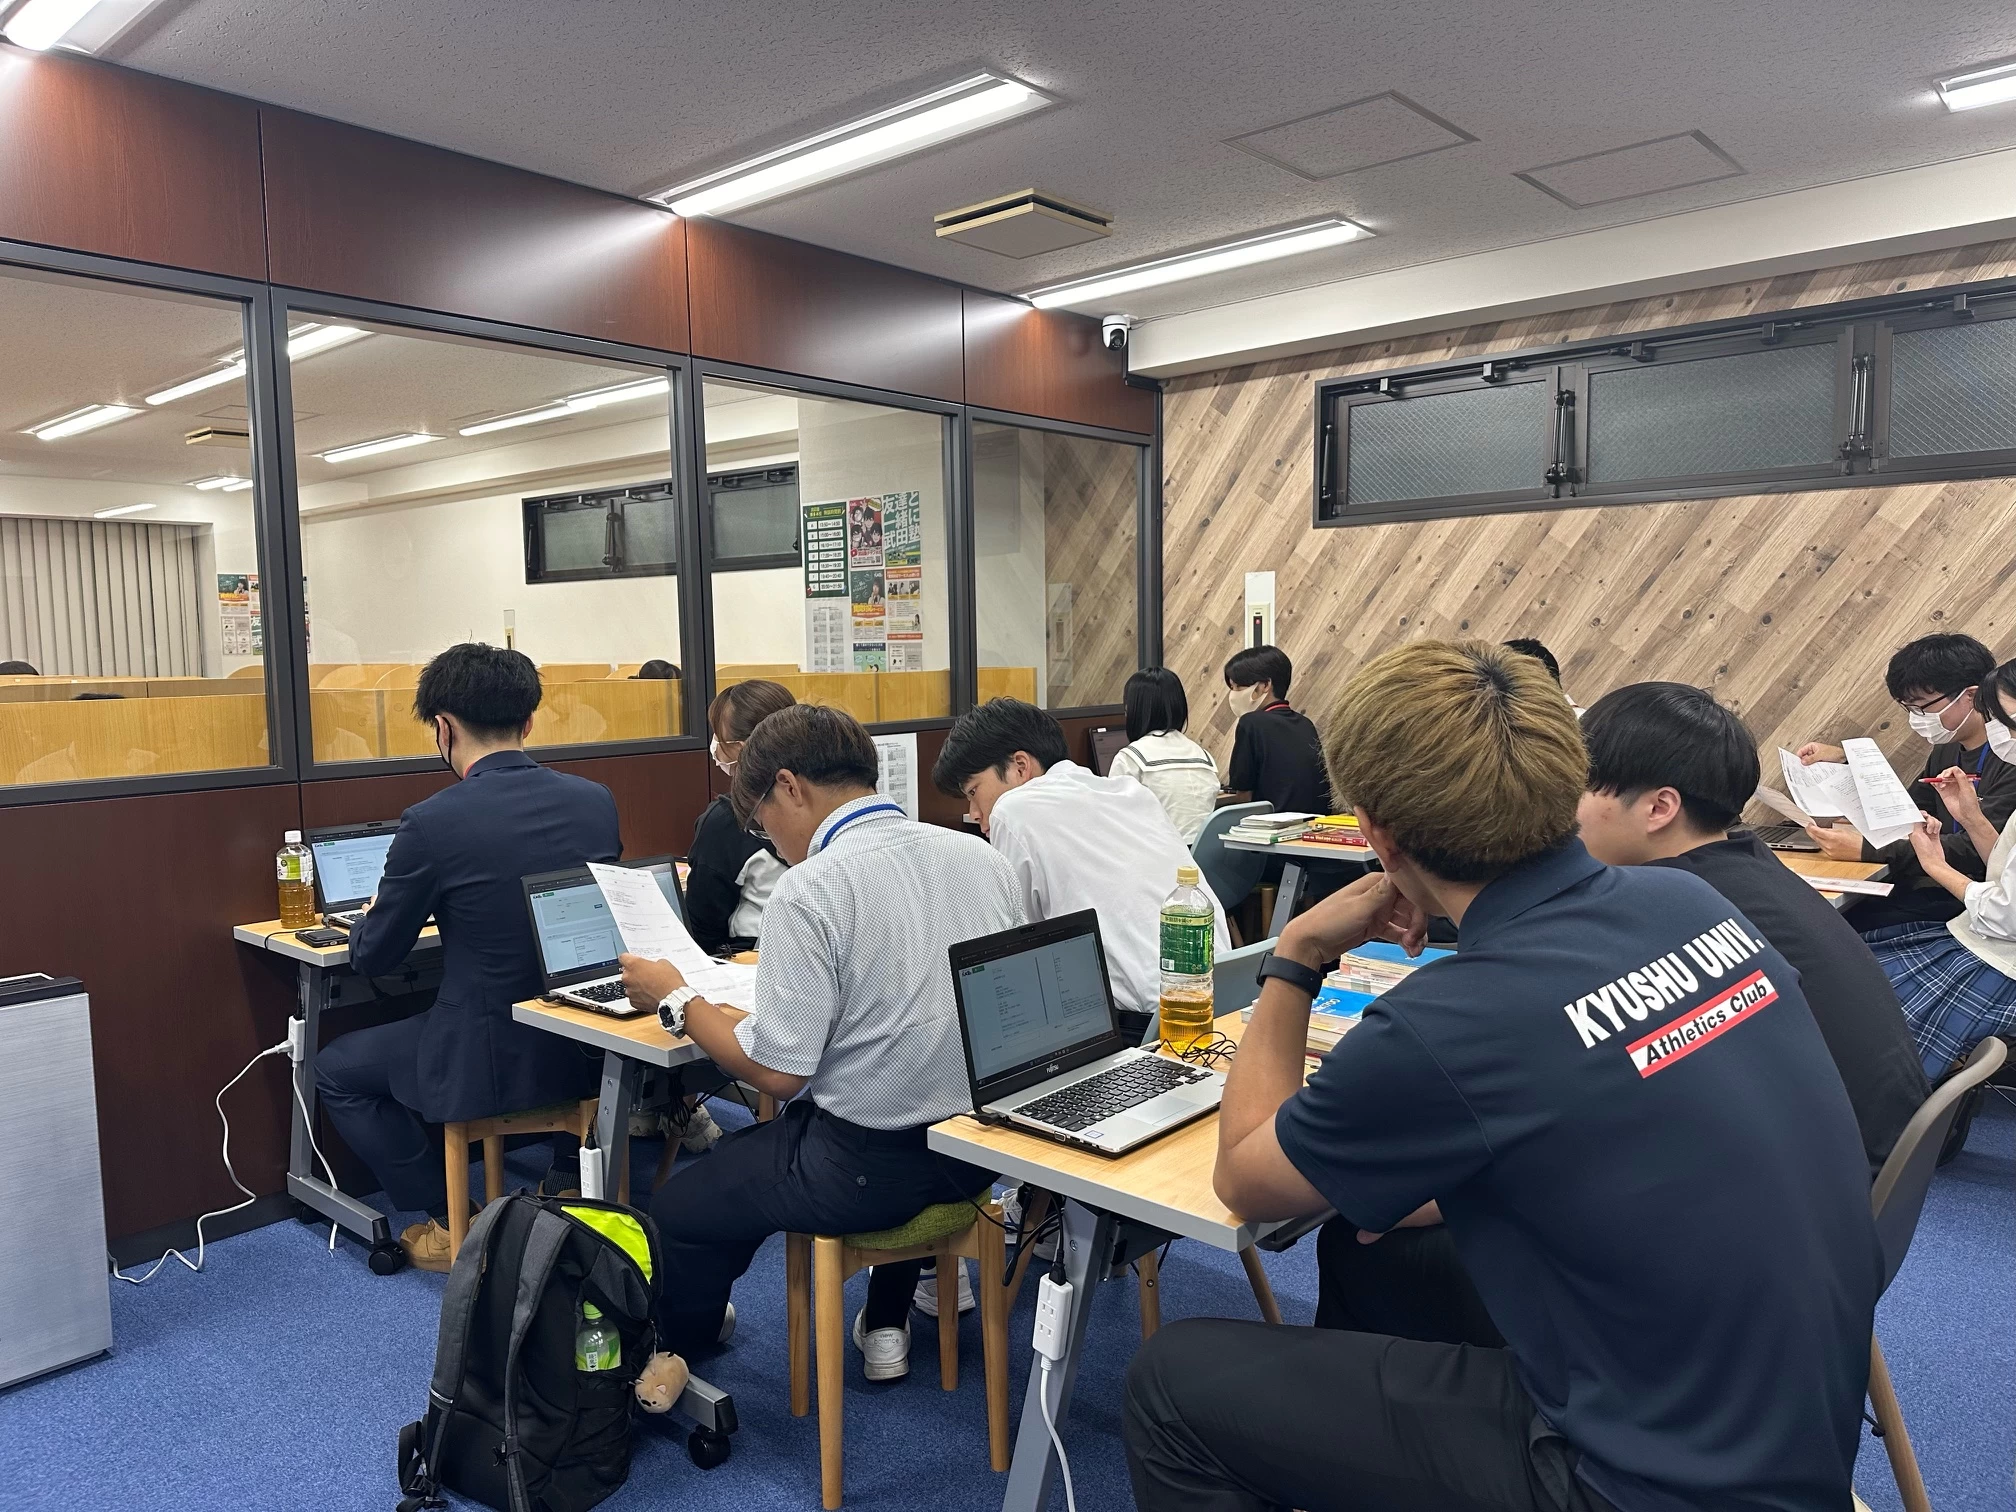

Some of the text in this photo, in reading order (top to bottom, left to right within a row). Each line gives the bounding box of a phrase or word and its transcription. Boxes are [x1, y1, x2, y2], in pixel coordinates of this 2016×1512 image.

[883, 491, 919, 514] 友達と
[884, 508, 920, 530] 一緒に
[884, 523, 920, 550] 武田塾
[1564, 918, 1765, 1049] KYUSHU UNIV.
[1646, 982, 1767, 1066] Athletics Club
